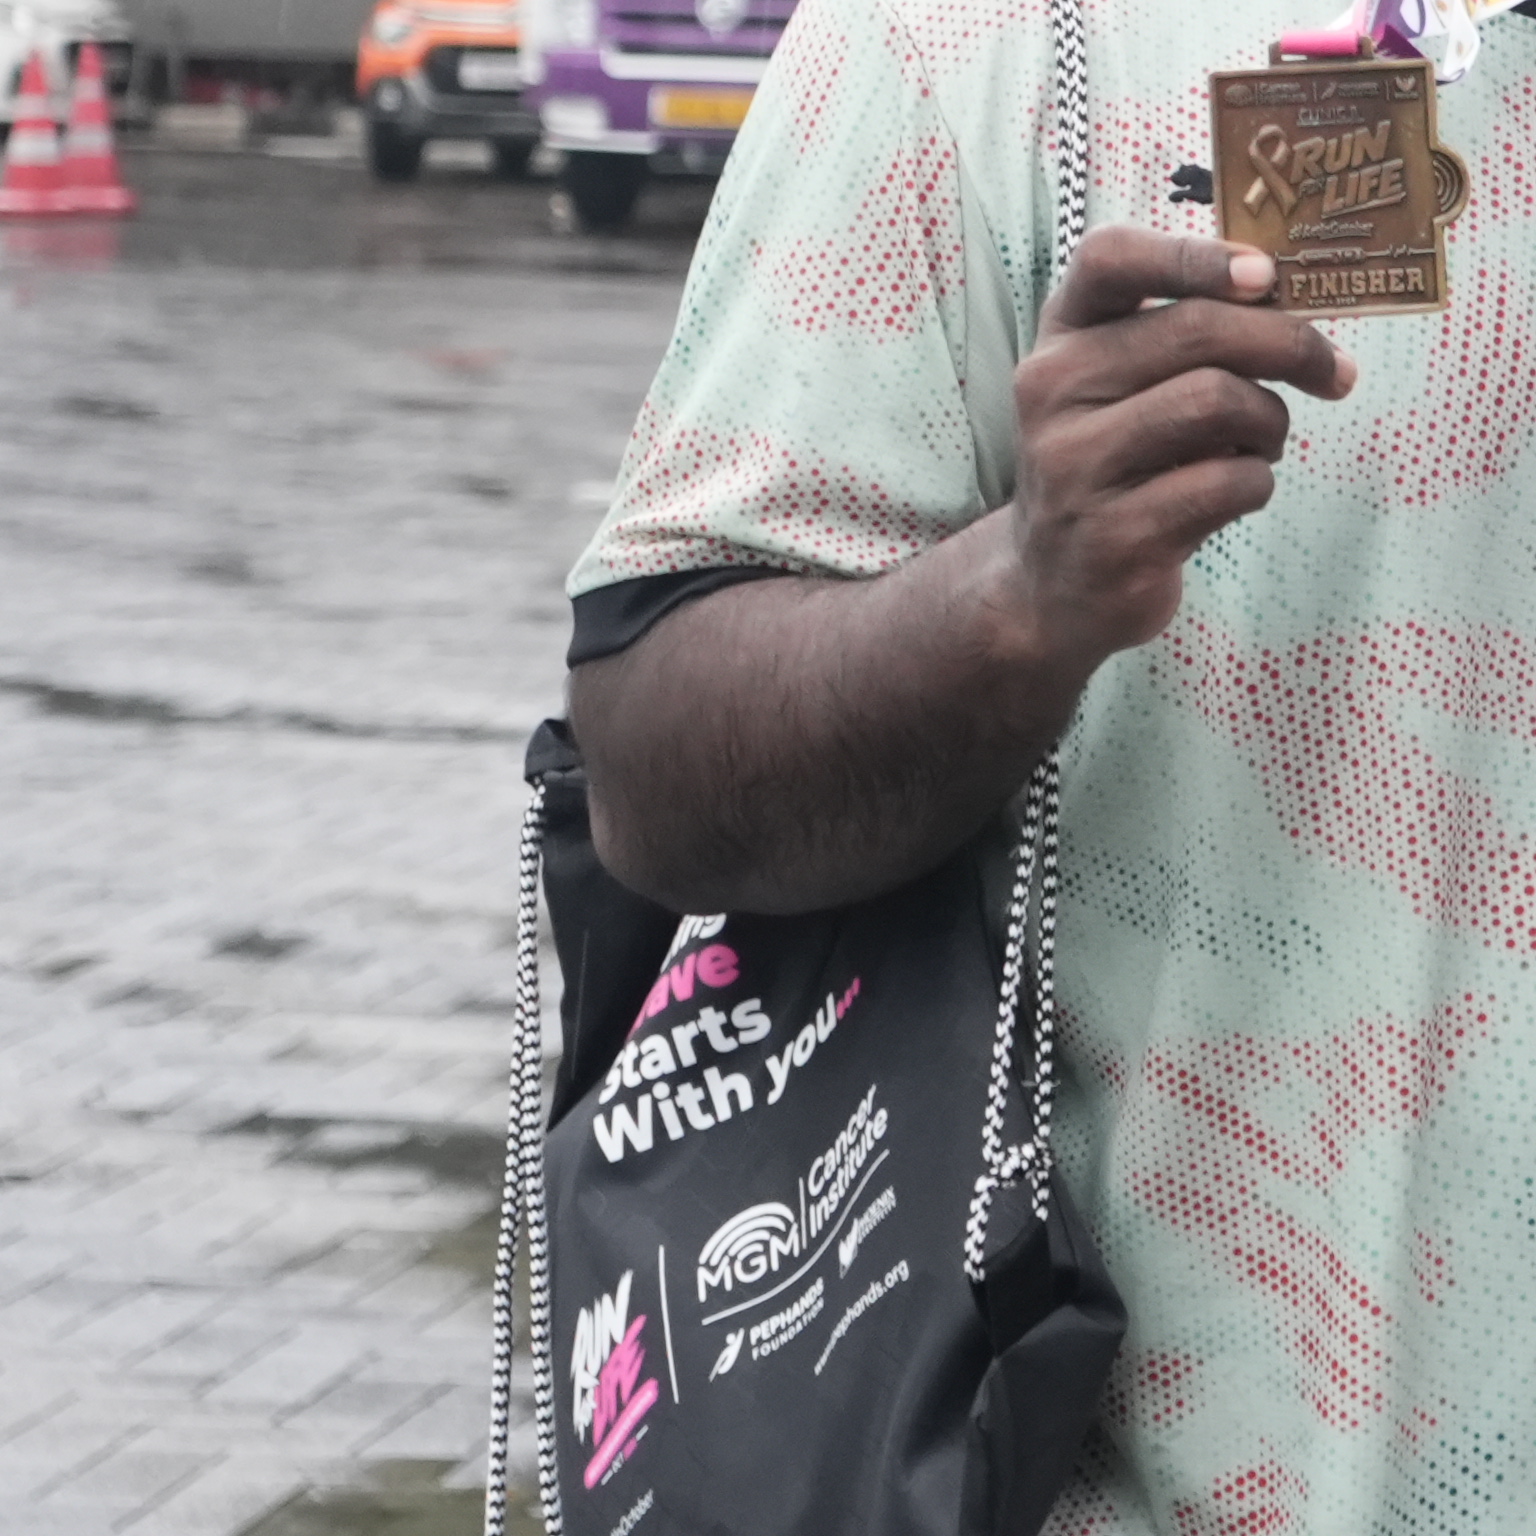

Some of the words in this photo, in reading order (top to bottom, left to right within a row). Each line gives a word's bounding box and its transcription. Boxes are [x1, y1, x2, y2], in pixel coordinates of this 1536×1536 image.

[1290, 120, 1392, 185] RUN
[1321, 157, 1405, 214] LIFE
[1291, 267, 1425, 299] FINISHER
[593, 1066, 754, 1164] With
[808, 1083, 877, 1197] Cancer
[809, 1107, 888, 1239] Institute
[697, 1221, 799, 1303] MGM
[570, 1268, 633, 1390] RUN
[750, 1276, 825, 1346] PEPHANDS
[752, 1296, 825, 1361] FOUNDATION
[592, 1314, 648, 1447] LIFE
